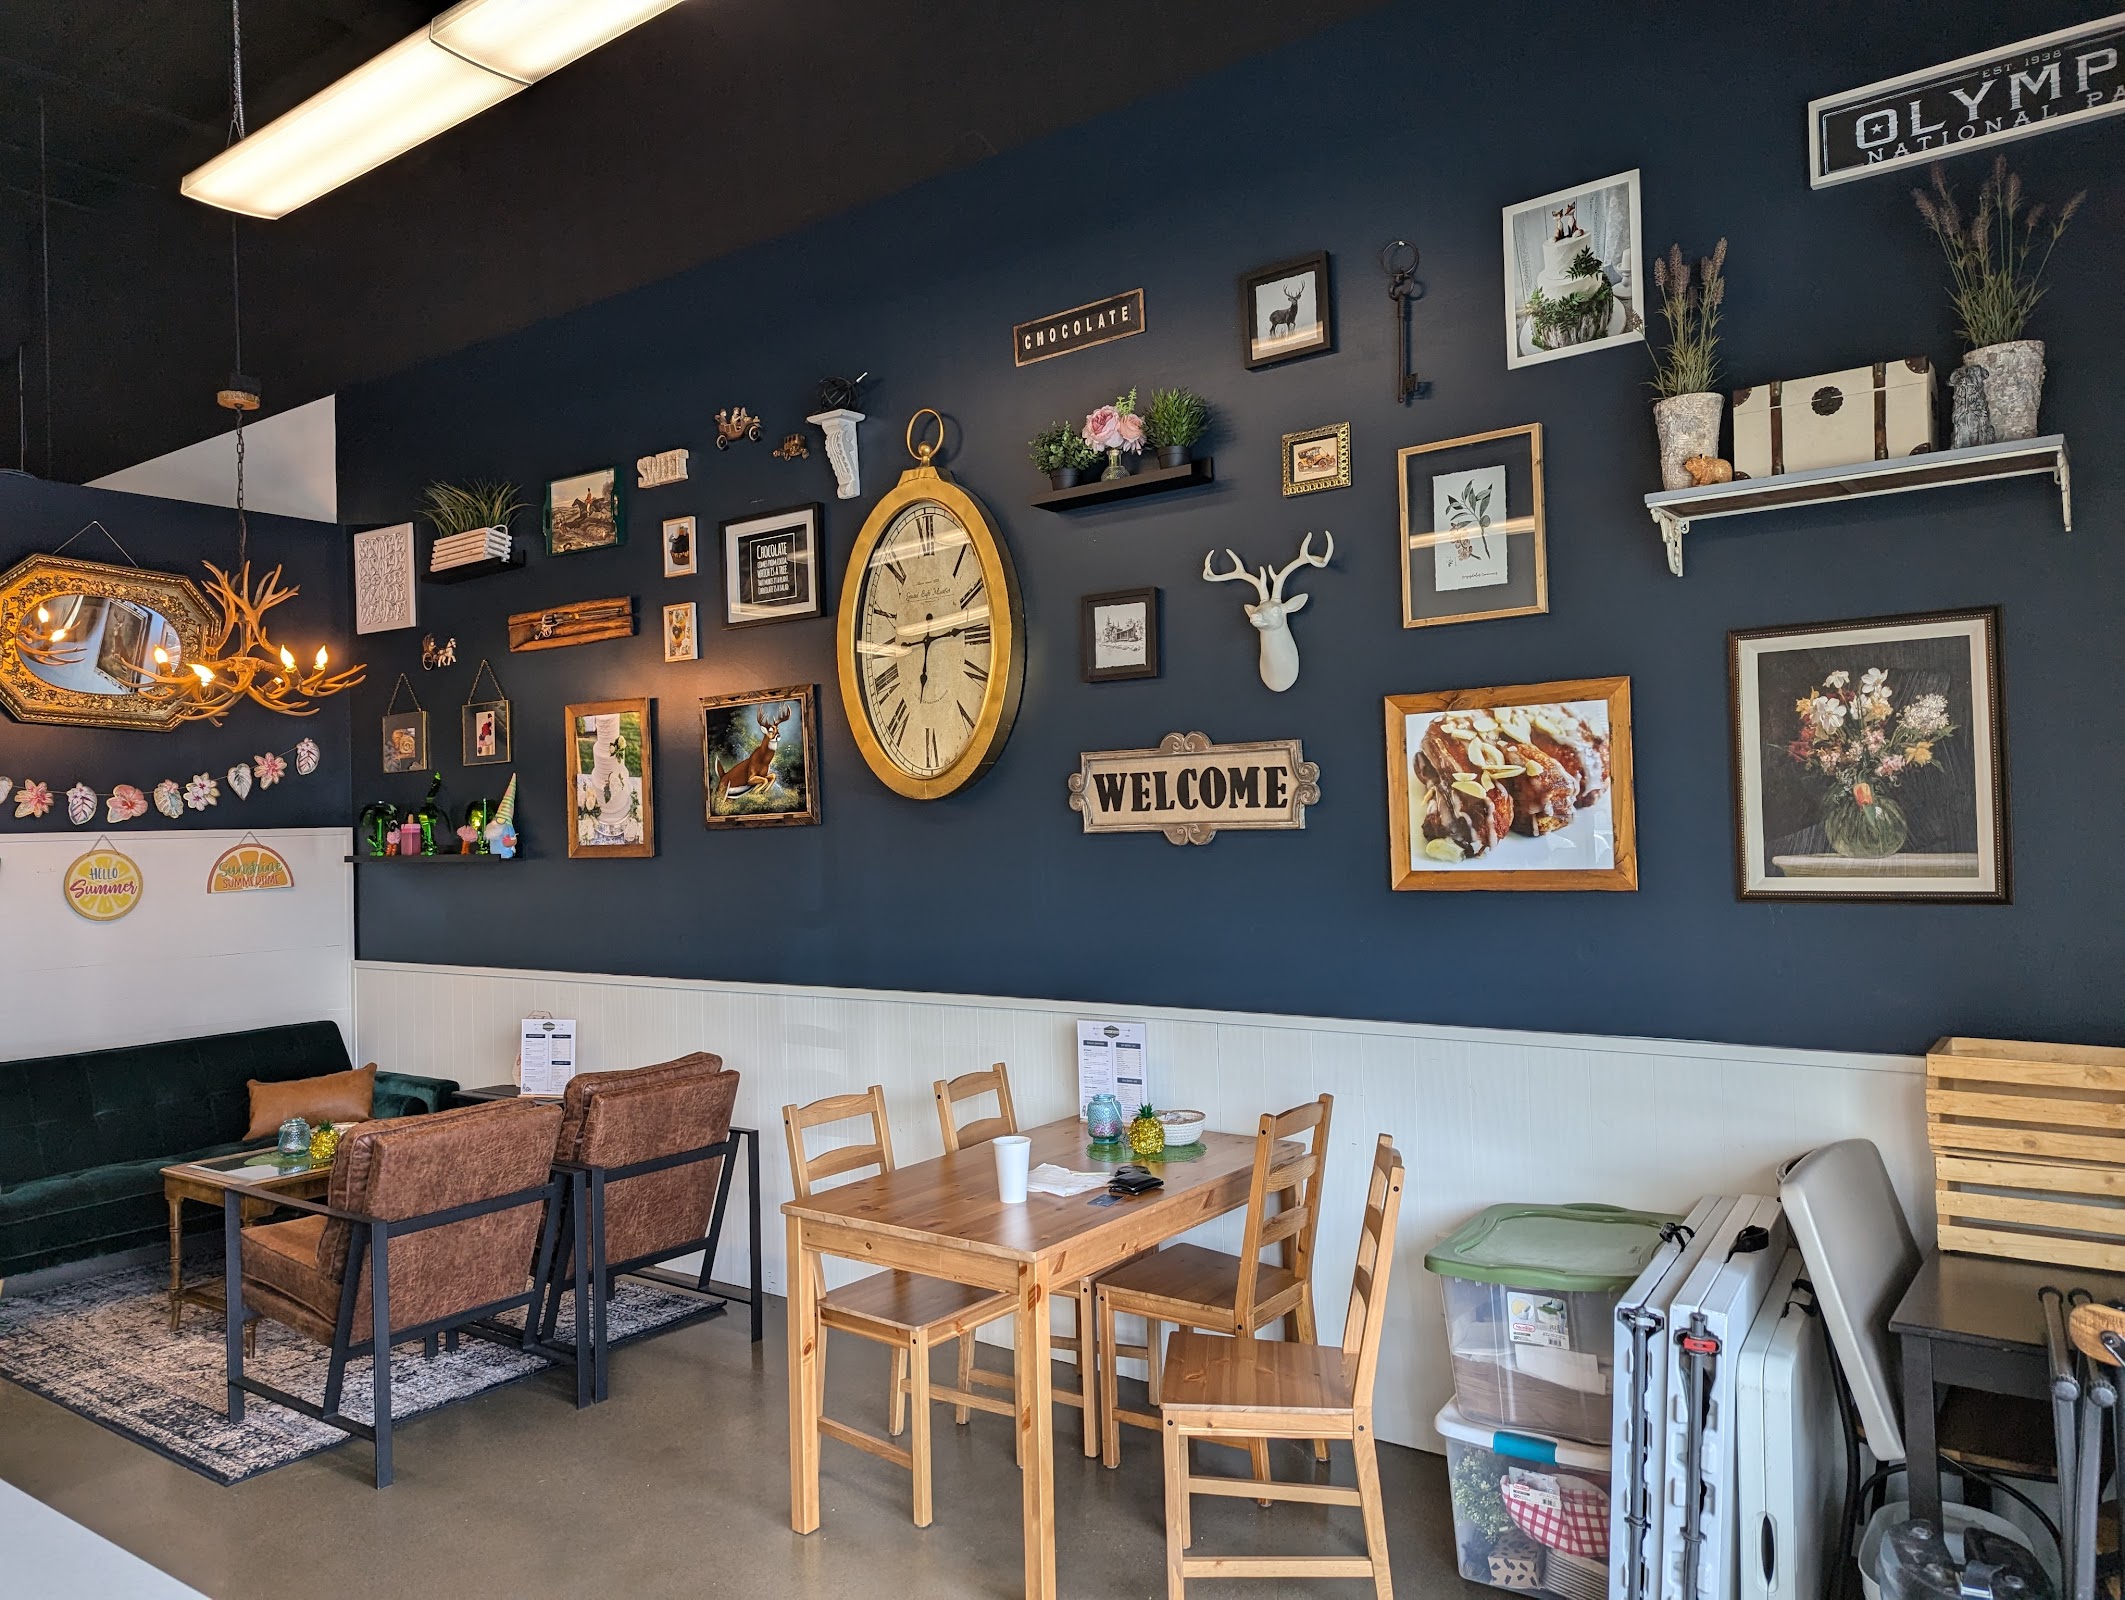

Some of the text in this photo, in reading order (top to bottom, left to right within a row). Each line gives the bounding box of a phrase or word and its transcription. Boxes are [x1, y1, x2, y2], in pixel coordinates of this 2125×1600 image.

[1981, 49, 2063, 79] EST. 1938
[1855, 48, 2118, 149] OLYMP
[1867, 104, 2059, 165] NATIONAL
[1024, 305, 1129, 350] CHOCOLATE
[757, 542, 787, 559] CHOCOLATE
[1092, 766, 1288, 812] WELCOME
[89, 867, 118, 880] HELLO
[218, 860, 283, 878] Sunshine
[222, 874, 281, 889] SUMMERTIME
[69, 879, 138, 899] Summer
